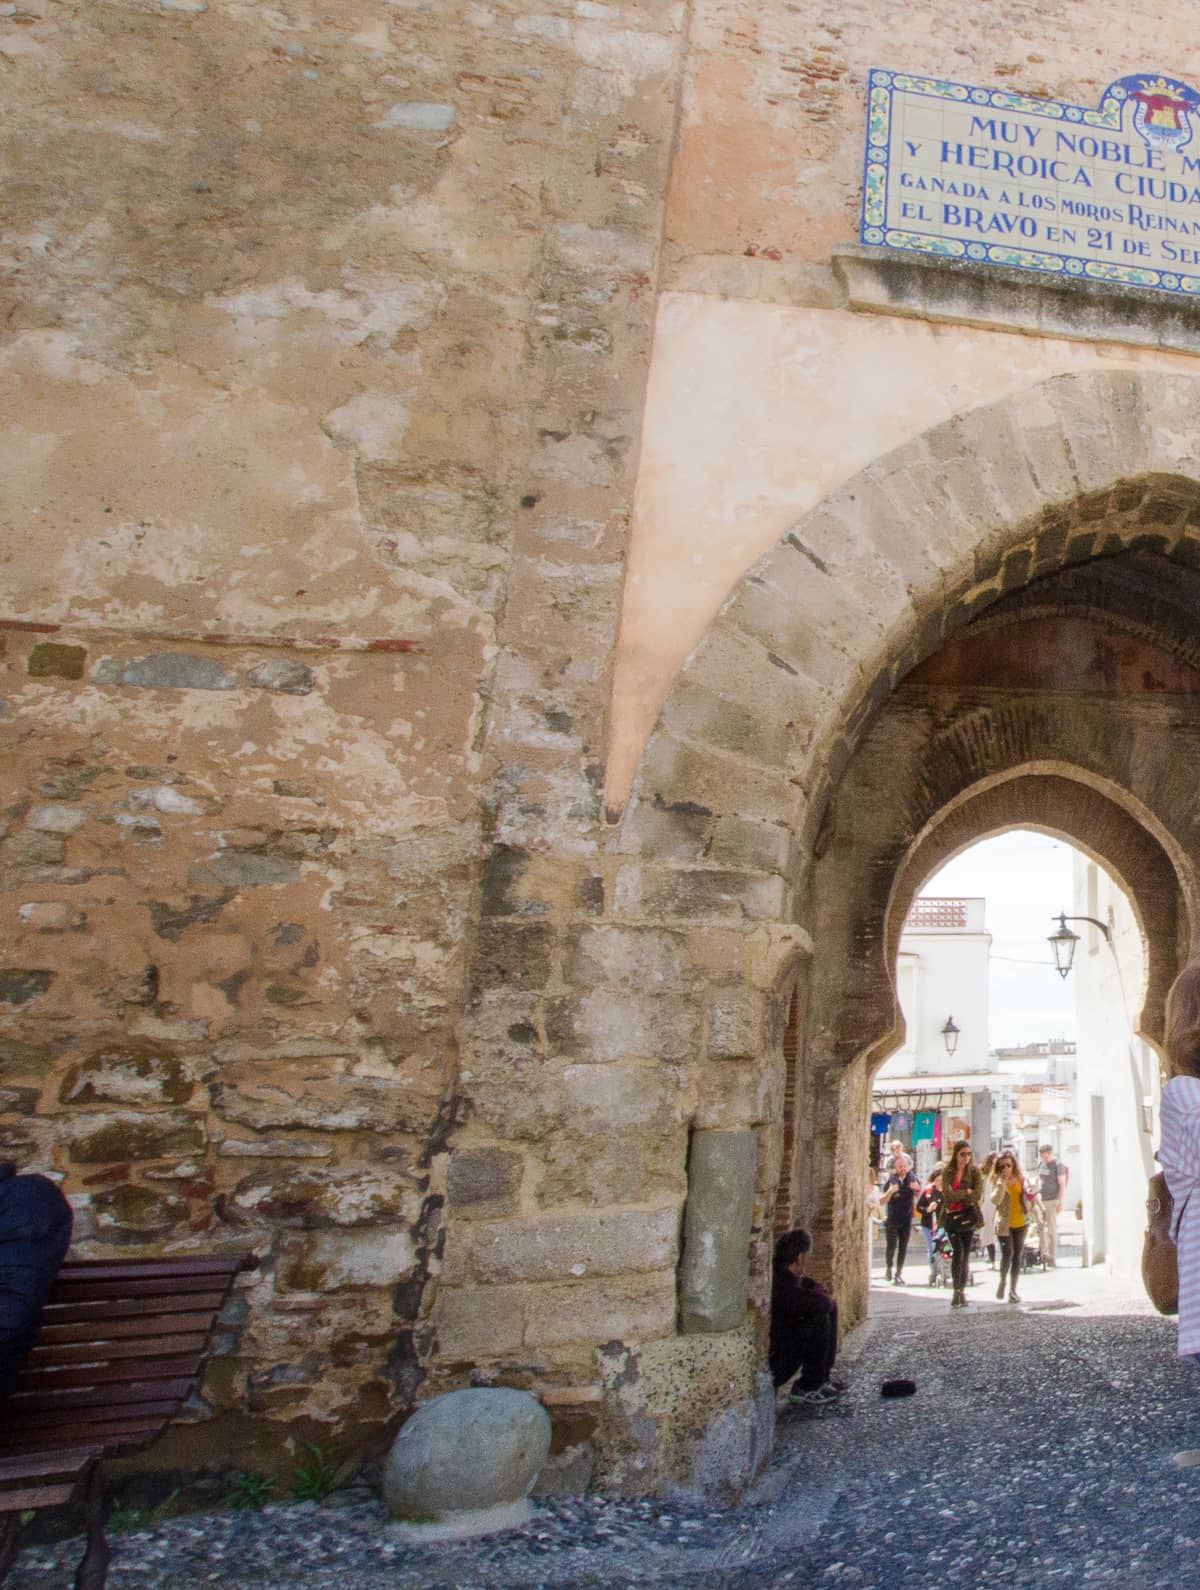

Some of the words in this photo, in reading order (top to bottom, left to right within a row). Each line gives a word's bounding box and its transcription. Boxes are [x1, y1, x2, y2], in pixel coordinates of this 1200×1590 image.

[905, 141, 922, 157] Y
[941, 141, 1093, 188] HEROICA
[970, 116, 1041, 147] MUY
[1056, 131, 1165, 172] NOBLE
[900, 173, 990, 201] GANADA
[999, 191, 1010, 204] A
[1018, 192, 1056, 211] LOS
[1061, 200, 1124, 223] MOROS
[901, 202, 932, 222] EL
[943, 204, 1037, 238] BRAVO
[1047, 226, 1076, 244] EN
[1088, 230, 1113, 251] 21
[1123, 239, 1152, 256] DE
